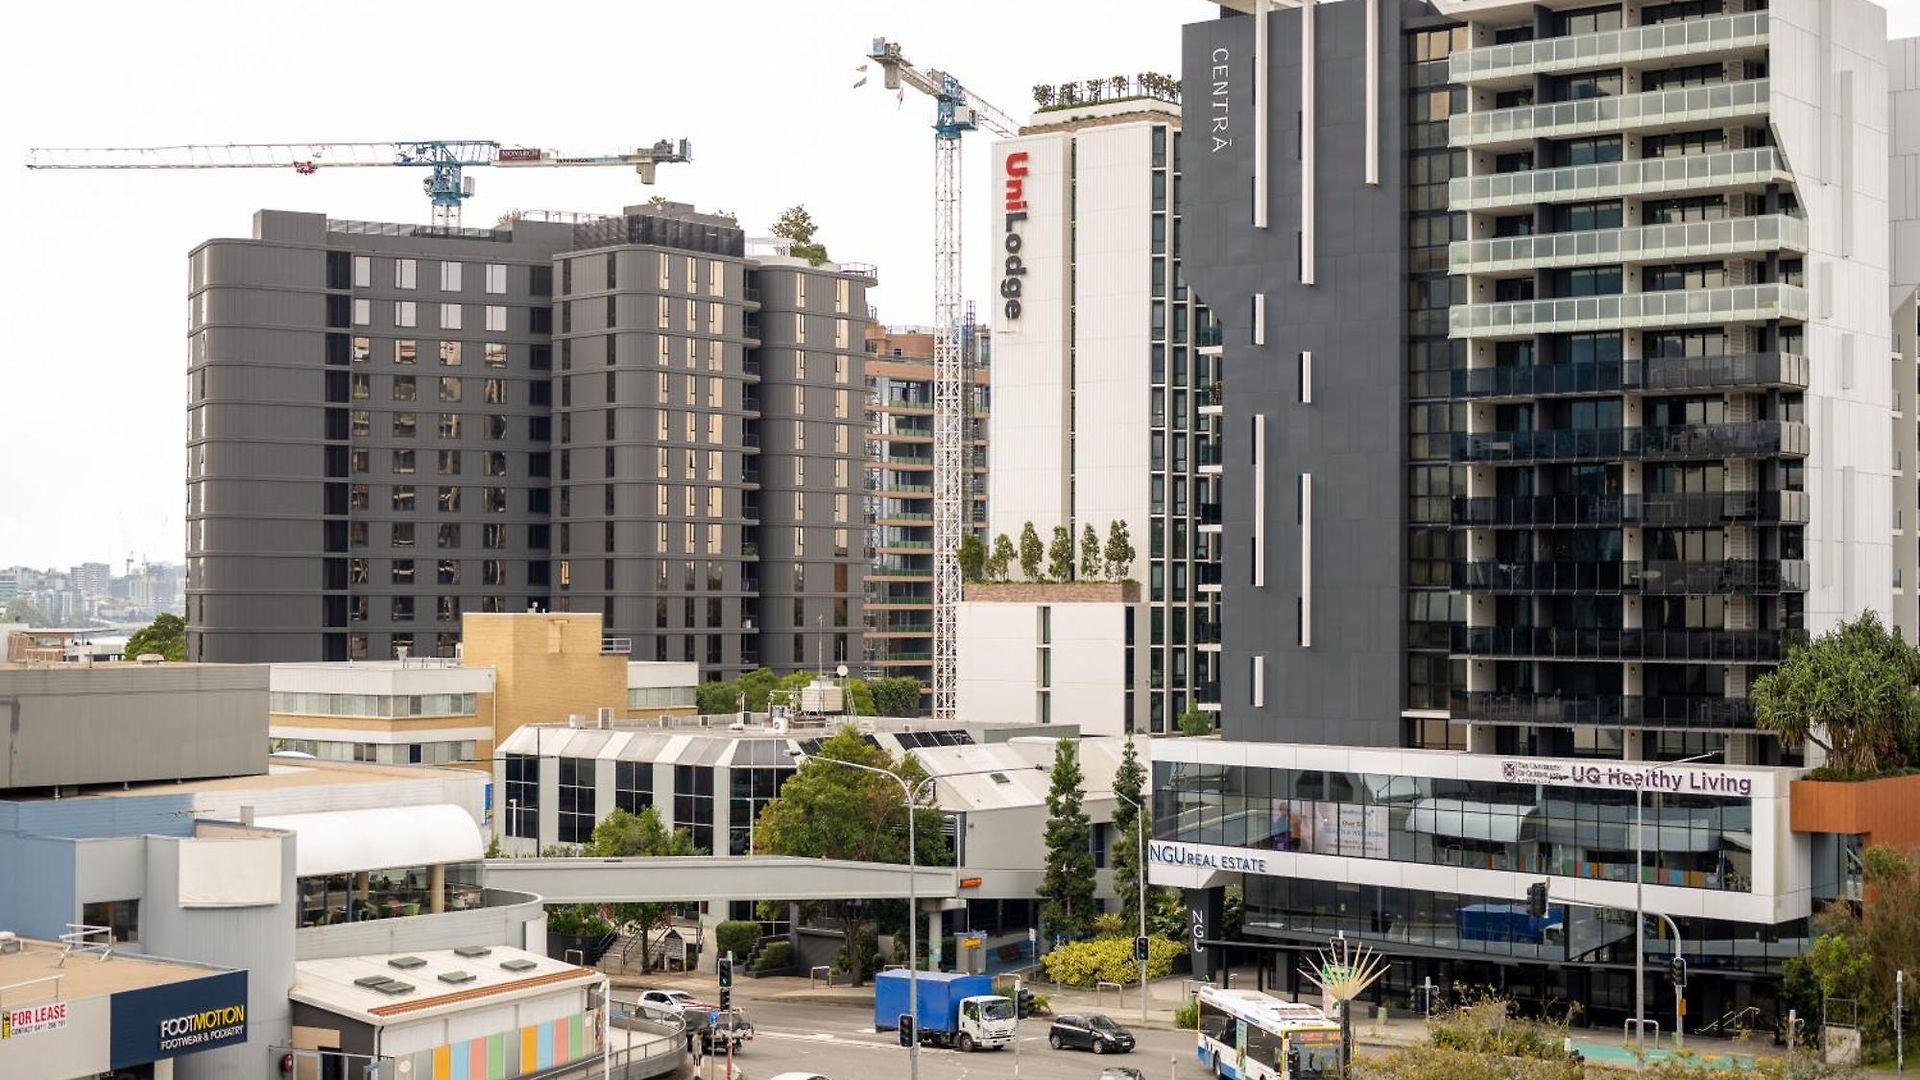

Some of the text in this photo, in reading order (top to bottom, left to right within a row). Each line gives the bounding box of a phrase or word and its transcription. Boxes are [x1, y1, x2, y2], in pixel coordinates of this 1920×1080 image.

[1000, 152, 1028, 320] UniLodge
[1572, 766, 1752, 795] UQ Healthy Living
[1149, 844, 1267, 873] NGU REAL ESTATE
[1192, 910, 1205, 952] NGU
[12, 1010, 32, 1027] FOR
[35, 1004, 66, 1022] LEASE
[161, 1005, 244, 1038] FOOTMOTION
[161, 1025, 244, 1050] FOOTWEAR & PODIATRY
